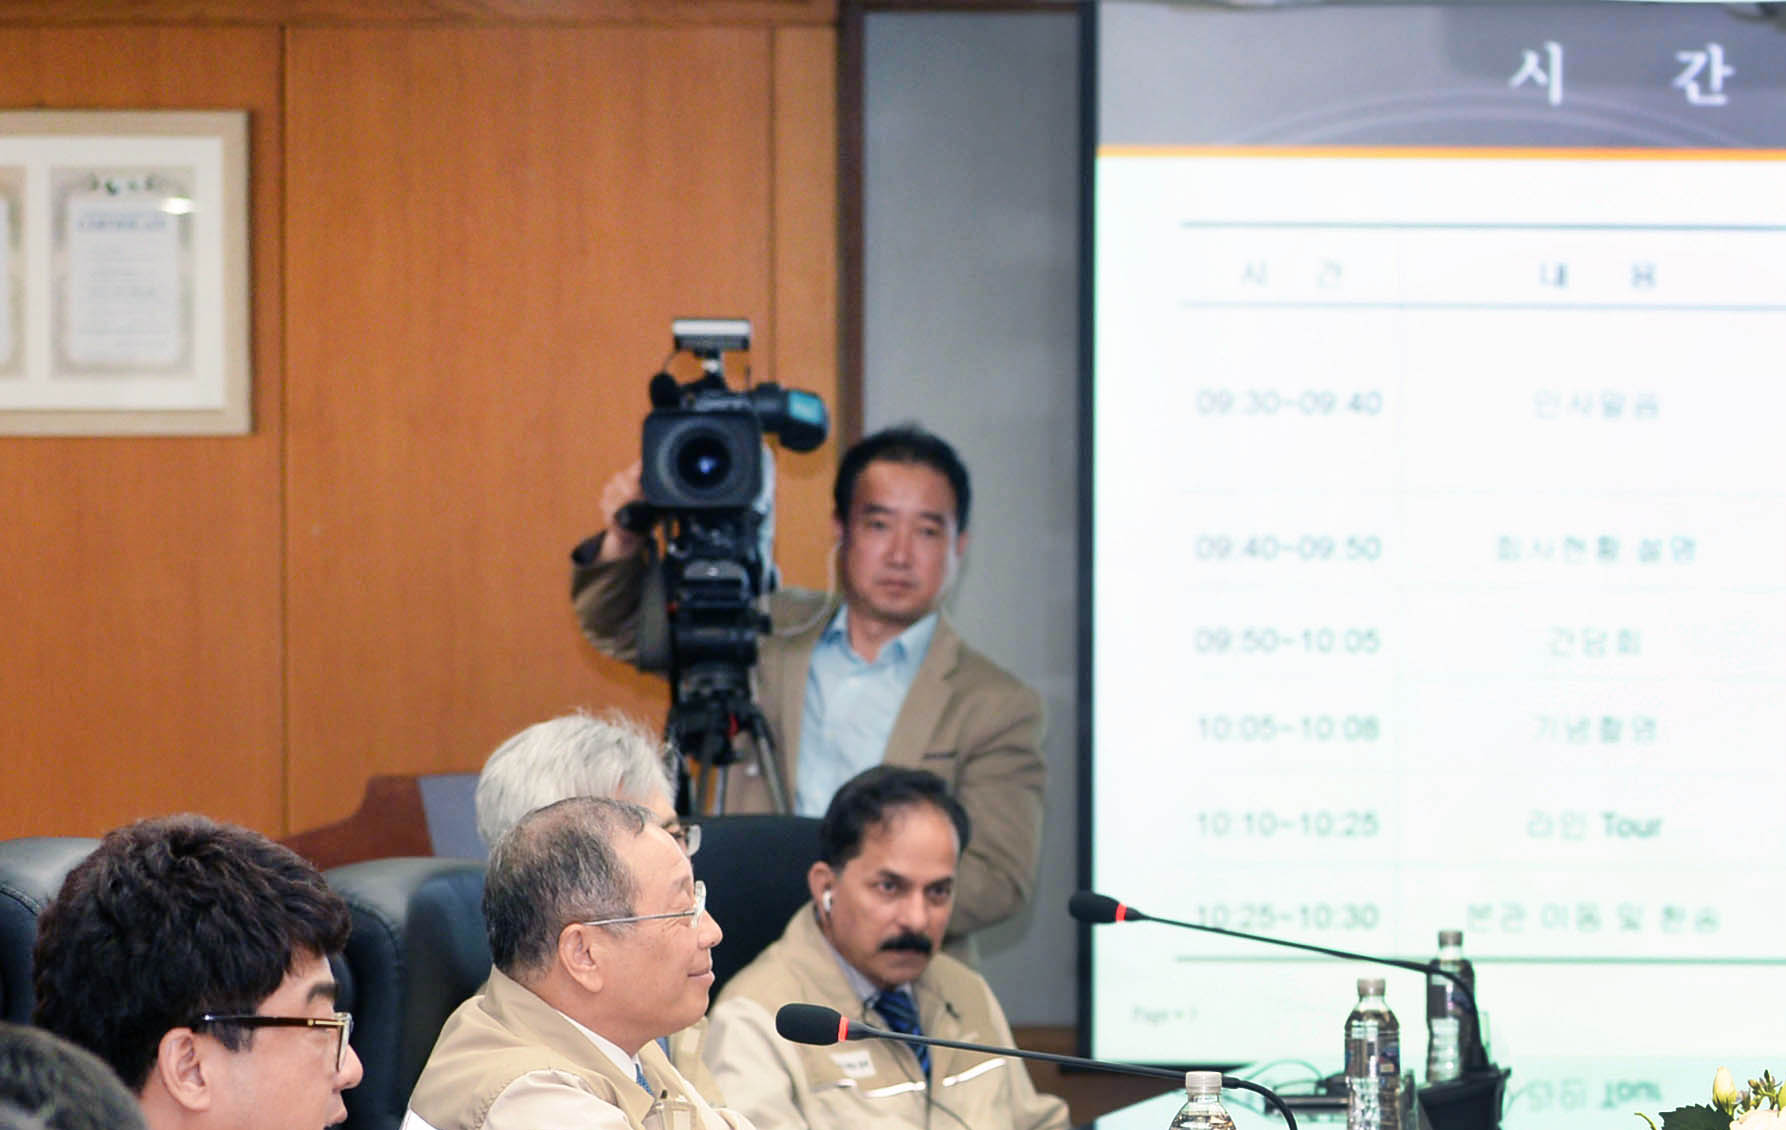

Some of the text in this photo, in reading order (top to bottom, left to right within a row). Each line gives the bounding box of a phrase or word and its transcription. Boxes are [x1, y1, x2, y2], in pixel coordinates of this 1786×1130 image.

[1508, 41, 1563, 106] 시
[1673, 43, 1735, 106] 간
[1600, 810, 1664, 840] Tour
